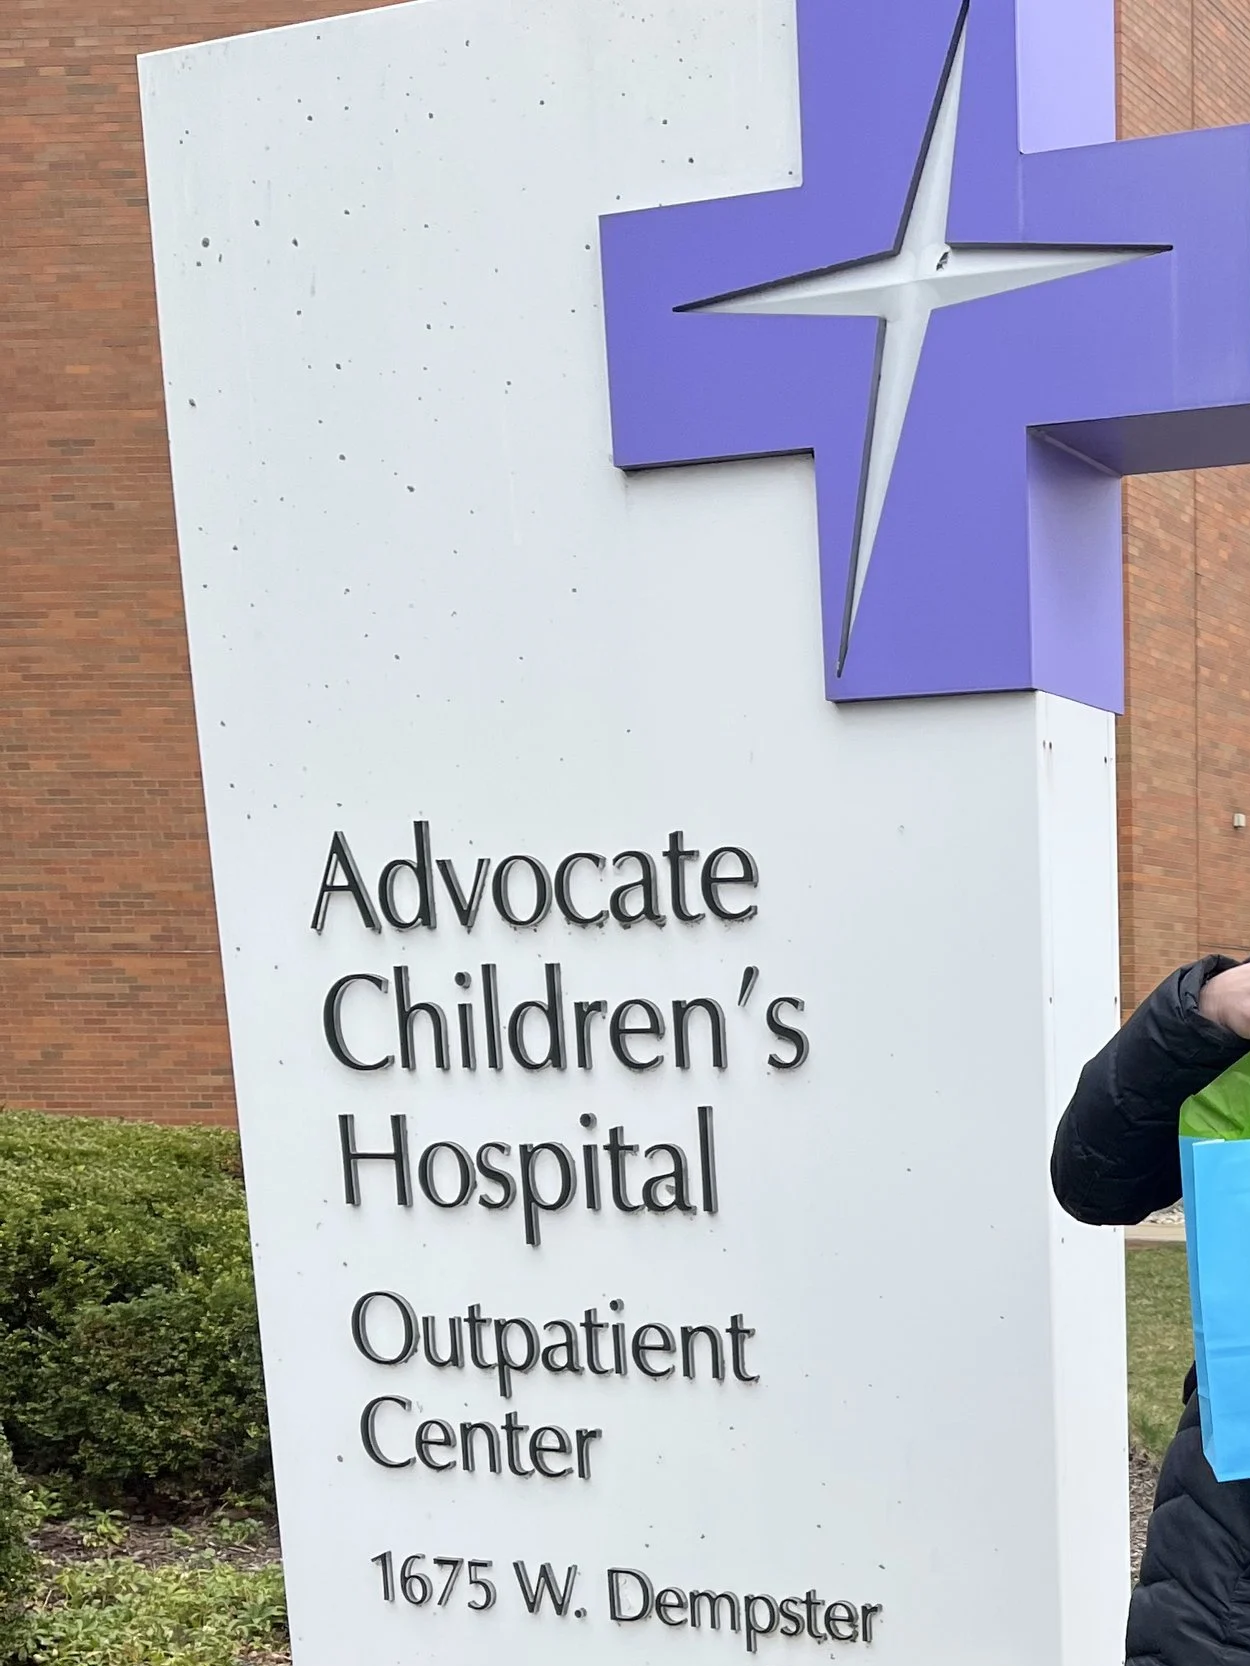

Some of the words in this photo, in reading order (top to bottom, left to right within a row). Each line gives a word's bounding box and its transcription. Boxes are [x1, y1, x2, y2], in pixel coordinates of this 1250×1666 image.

[310, 820, 760, 934] Advocate
[322, 963, 809, 1071] Children's
[337, 1105, 719, 1246] Hospital
[351, 1290, 760, 1399] Outpatient
[360, 1395, 602, 1480] Center
[370, 1550, 498, 1612] 1675
[513, 1560, 587, 1618] W.
[607, 1567, 883, 1653] Dempster
